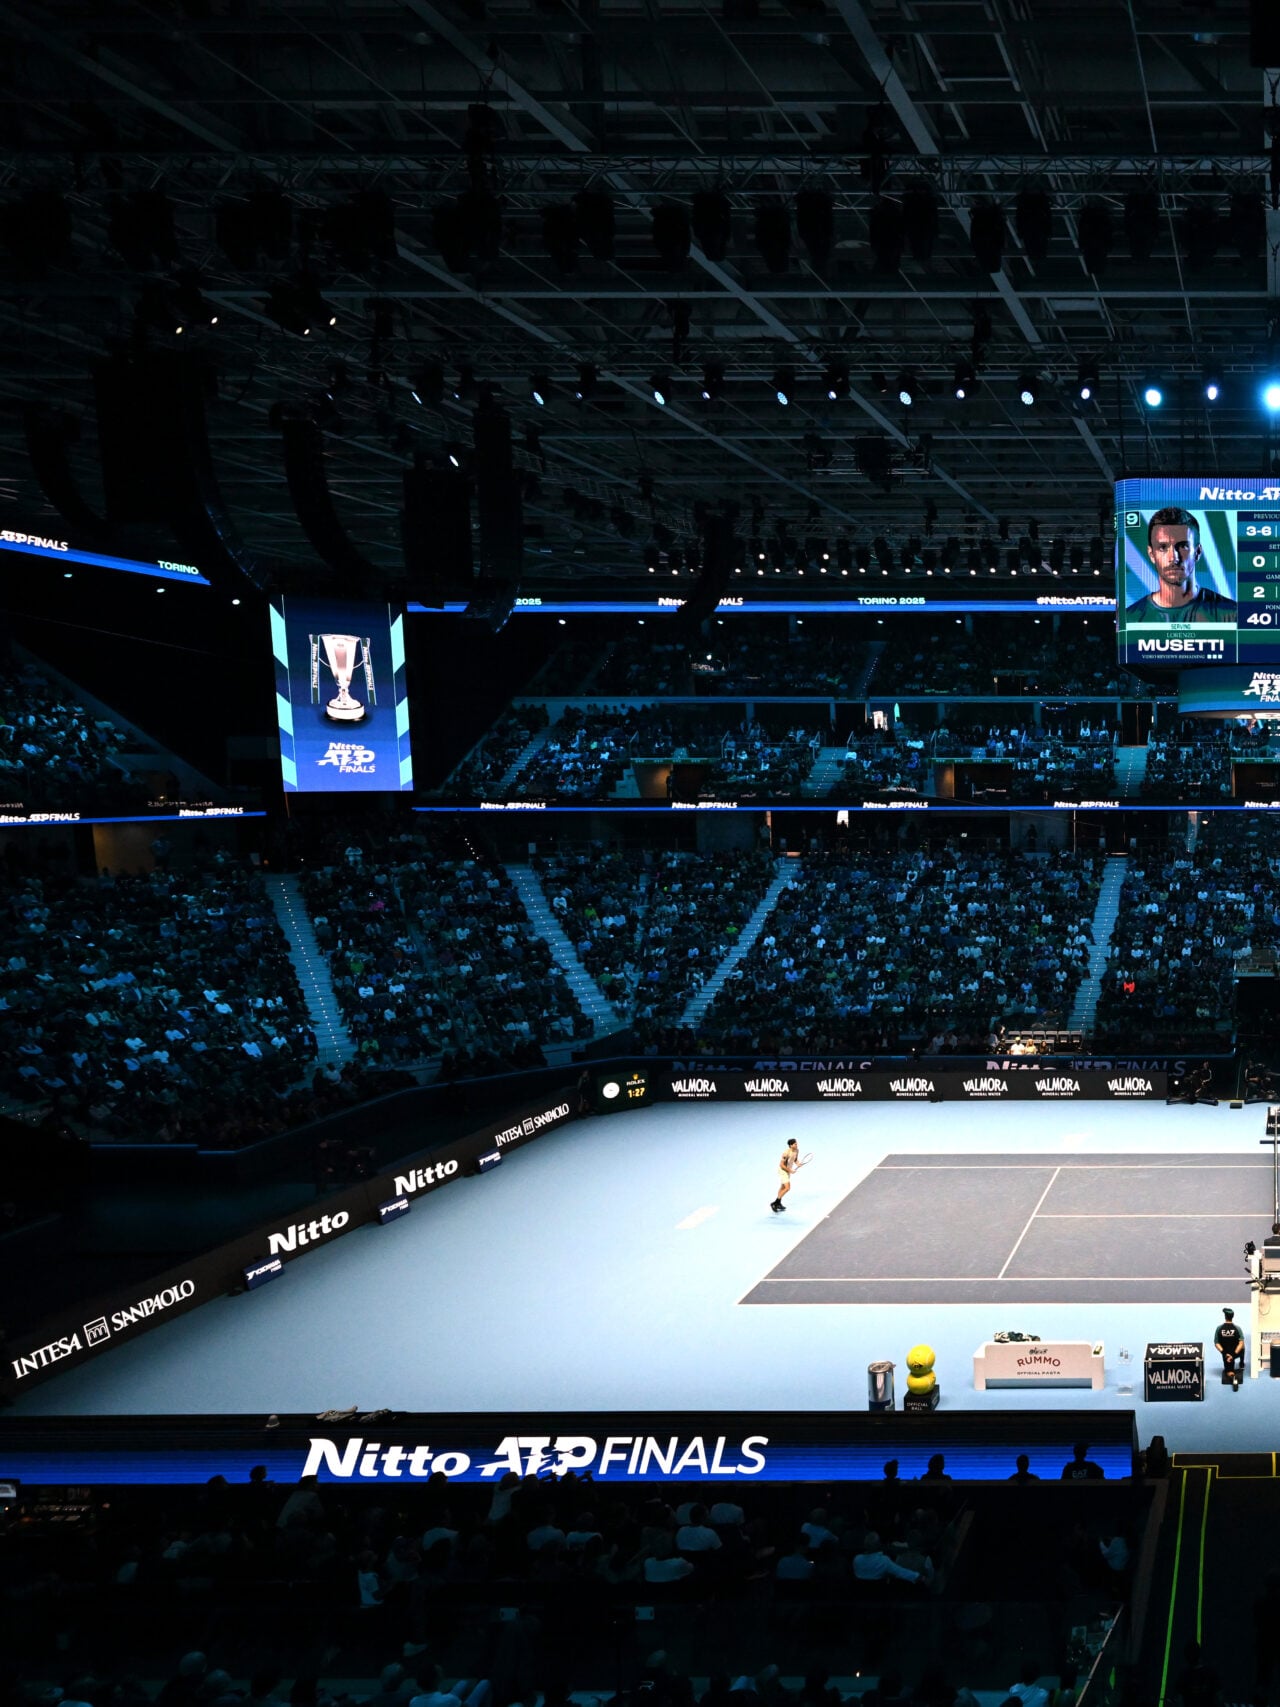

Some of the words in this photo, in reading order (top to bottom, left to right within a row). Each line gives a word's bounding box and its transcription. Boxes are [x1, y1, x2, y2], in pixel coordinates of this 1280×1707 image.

[1199, 487, 1256, 501] Nitto
[1126, 513, 1139, 525] 9
[1246, 526, 1272, 536] 3-6
[27, 535, 69, 552] FINALS
[157, 560, 200, 575] TORINO
[1252, 556, 1266, 568] 0
[1253, 586, 1266, 598] 2
[658, 598, 688, 606] Nitt
[718, 598, 744, 606] NALS
[1036, 597, 1116, 605] #NittoATPFin
[1246, 613, 1272, 625] 40
[1137, 640, 1224, 651] MUSETTI
[328, 743, 365, 751] Nitto
[315, 751, 375, 766] ATP
[339, 765, 376, 773] FINALS
[49, 813, 80, 822] FINALS
[220, 807, 244, 816] FINALS
[671, 1079, 717, 1093] VALMORA
[744, 1079, 790, 1093] VALMORA
[816, 1078, 862, 1093] VALMORA
[889, 1078, 935, 1093] VALMORA
[963, 1078, 1008, 1093] VALMORA
[1035, 1078, 1081, 1092] VALMORA
[1107, 1077, 1153, 1092] VALMORA
[627, 1088, 646, 1098] 1:27
[494, 1125, 523, 1147] INTESA
[534, 1103, 569, 1129] SANPAOLO
[393, 1159, 459, 1196] Nitto
[267, 1211, 350, 1255] Nitto
[11, 1333, 83, 1379] INTESA
[111, 1280, 195, 1332] SANPAOLO
[1149, 1347, 1200, 1355] VALMORA
[1016, 1356, 1061, 1367] RUMMO
[1149, 1370, 1200, 1385] VALMORA
[301, 1438, 471, 1478] Nitto
[474, 1436, 597, 1477] ATP
[598, 1436, 769, 1475] FINALS
